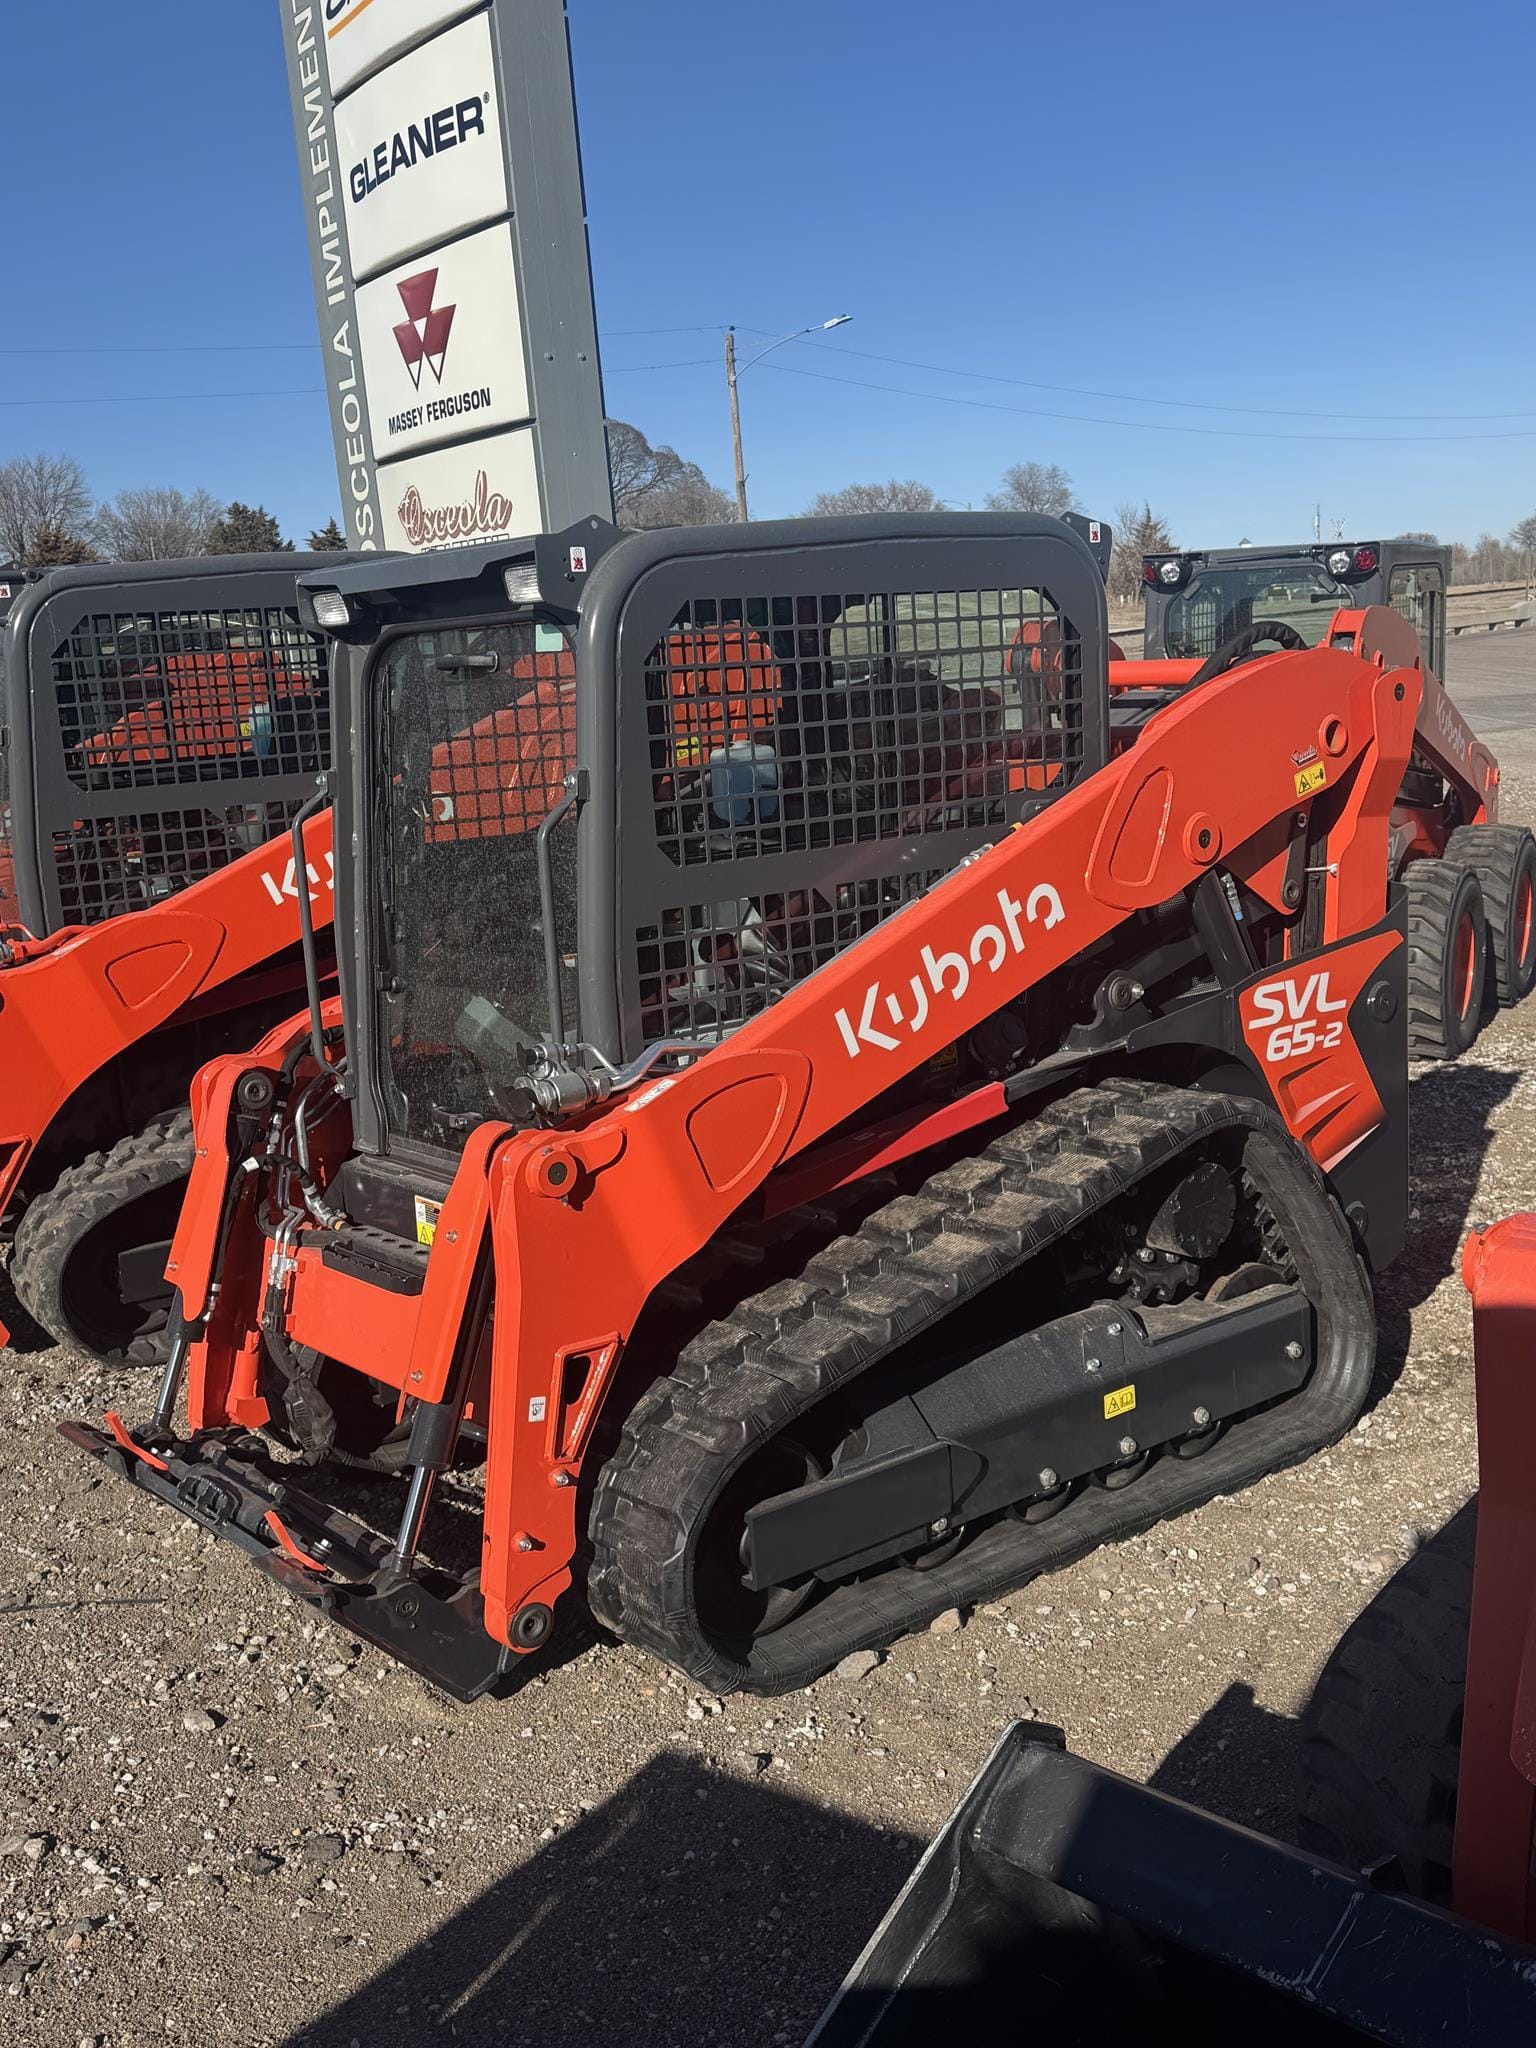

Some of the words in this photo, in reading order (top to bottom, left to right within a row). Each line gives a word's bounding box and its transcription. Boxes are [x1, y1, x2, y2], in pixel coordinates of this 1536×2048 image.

[292, 0, 346, 306] IMPLEMEN
[388, 406, 423, 435] MASSEY
[426, 387, 491, 423] FERGUSON
[398, 469, 512, 545] Osceola
[834, 883, 1066, 1059] Kubota
[1248, 972, 1347, 1030] SVL
[1266, 1019, 1343, 1062] 65-2
